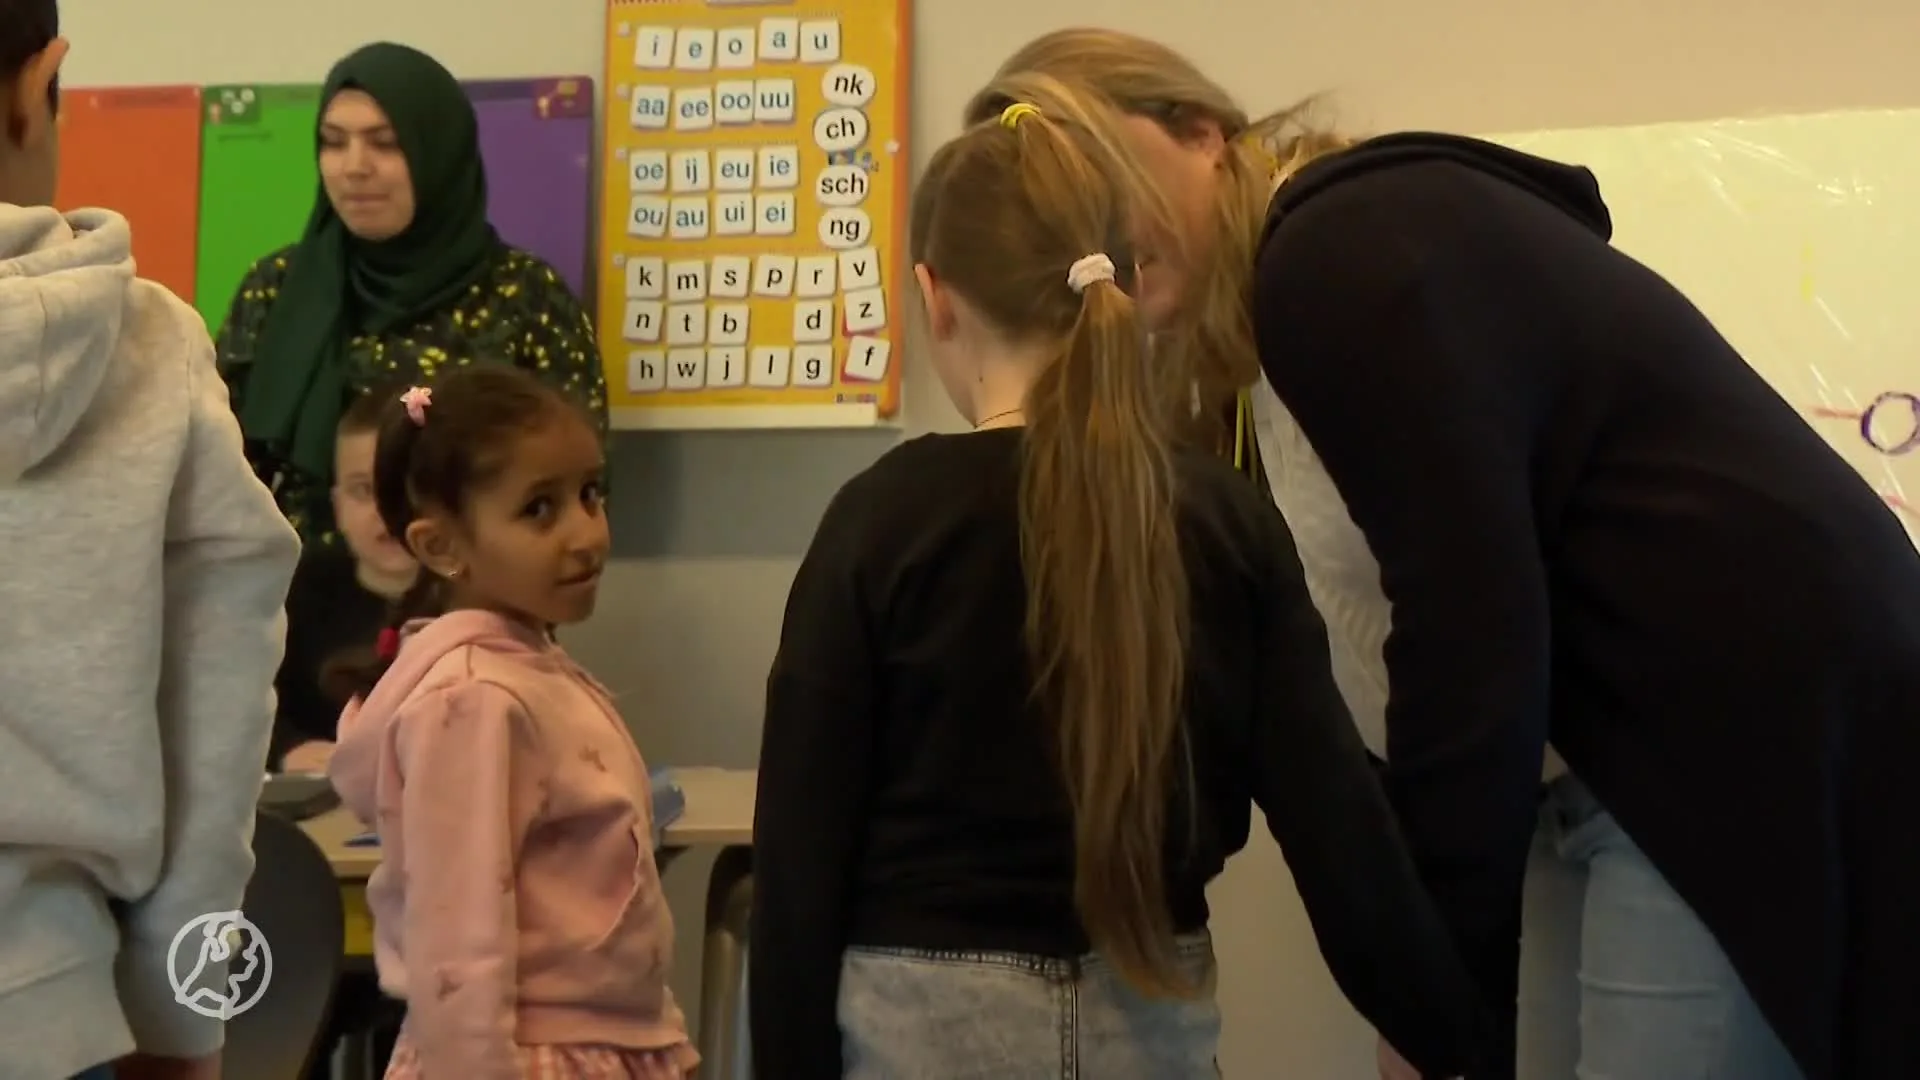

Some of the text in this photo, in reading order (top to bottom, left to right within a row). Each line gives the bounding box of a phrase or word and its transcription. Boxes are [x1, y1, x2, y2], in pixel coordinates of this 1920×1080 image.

[651, 31, 828, 59] i e o a u
[834, 73, 863, 96] nk
[636, 92, 790, 119] aa ee oo uu
[825, 117, 856, 139] ch
[634, 155, 790, 185] oe ij eu ie
[820, 173, 865, 194] sch
[633, 201, 786, 229] ou au ui ei
[830, 219, 860, 242] ng
[639, 260, 866, 290] k m s p r v
[635, 302, 873, 334] n t b d z
[640, 346, 875, 381] h w j l g f
